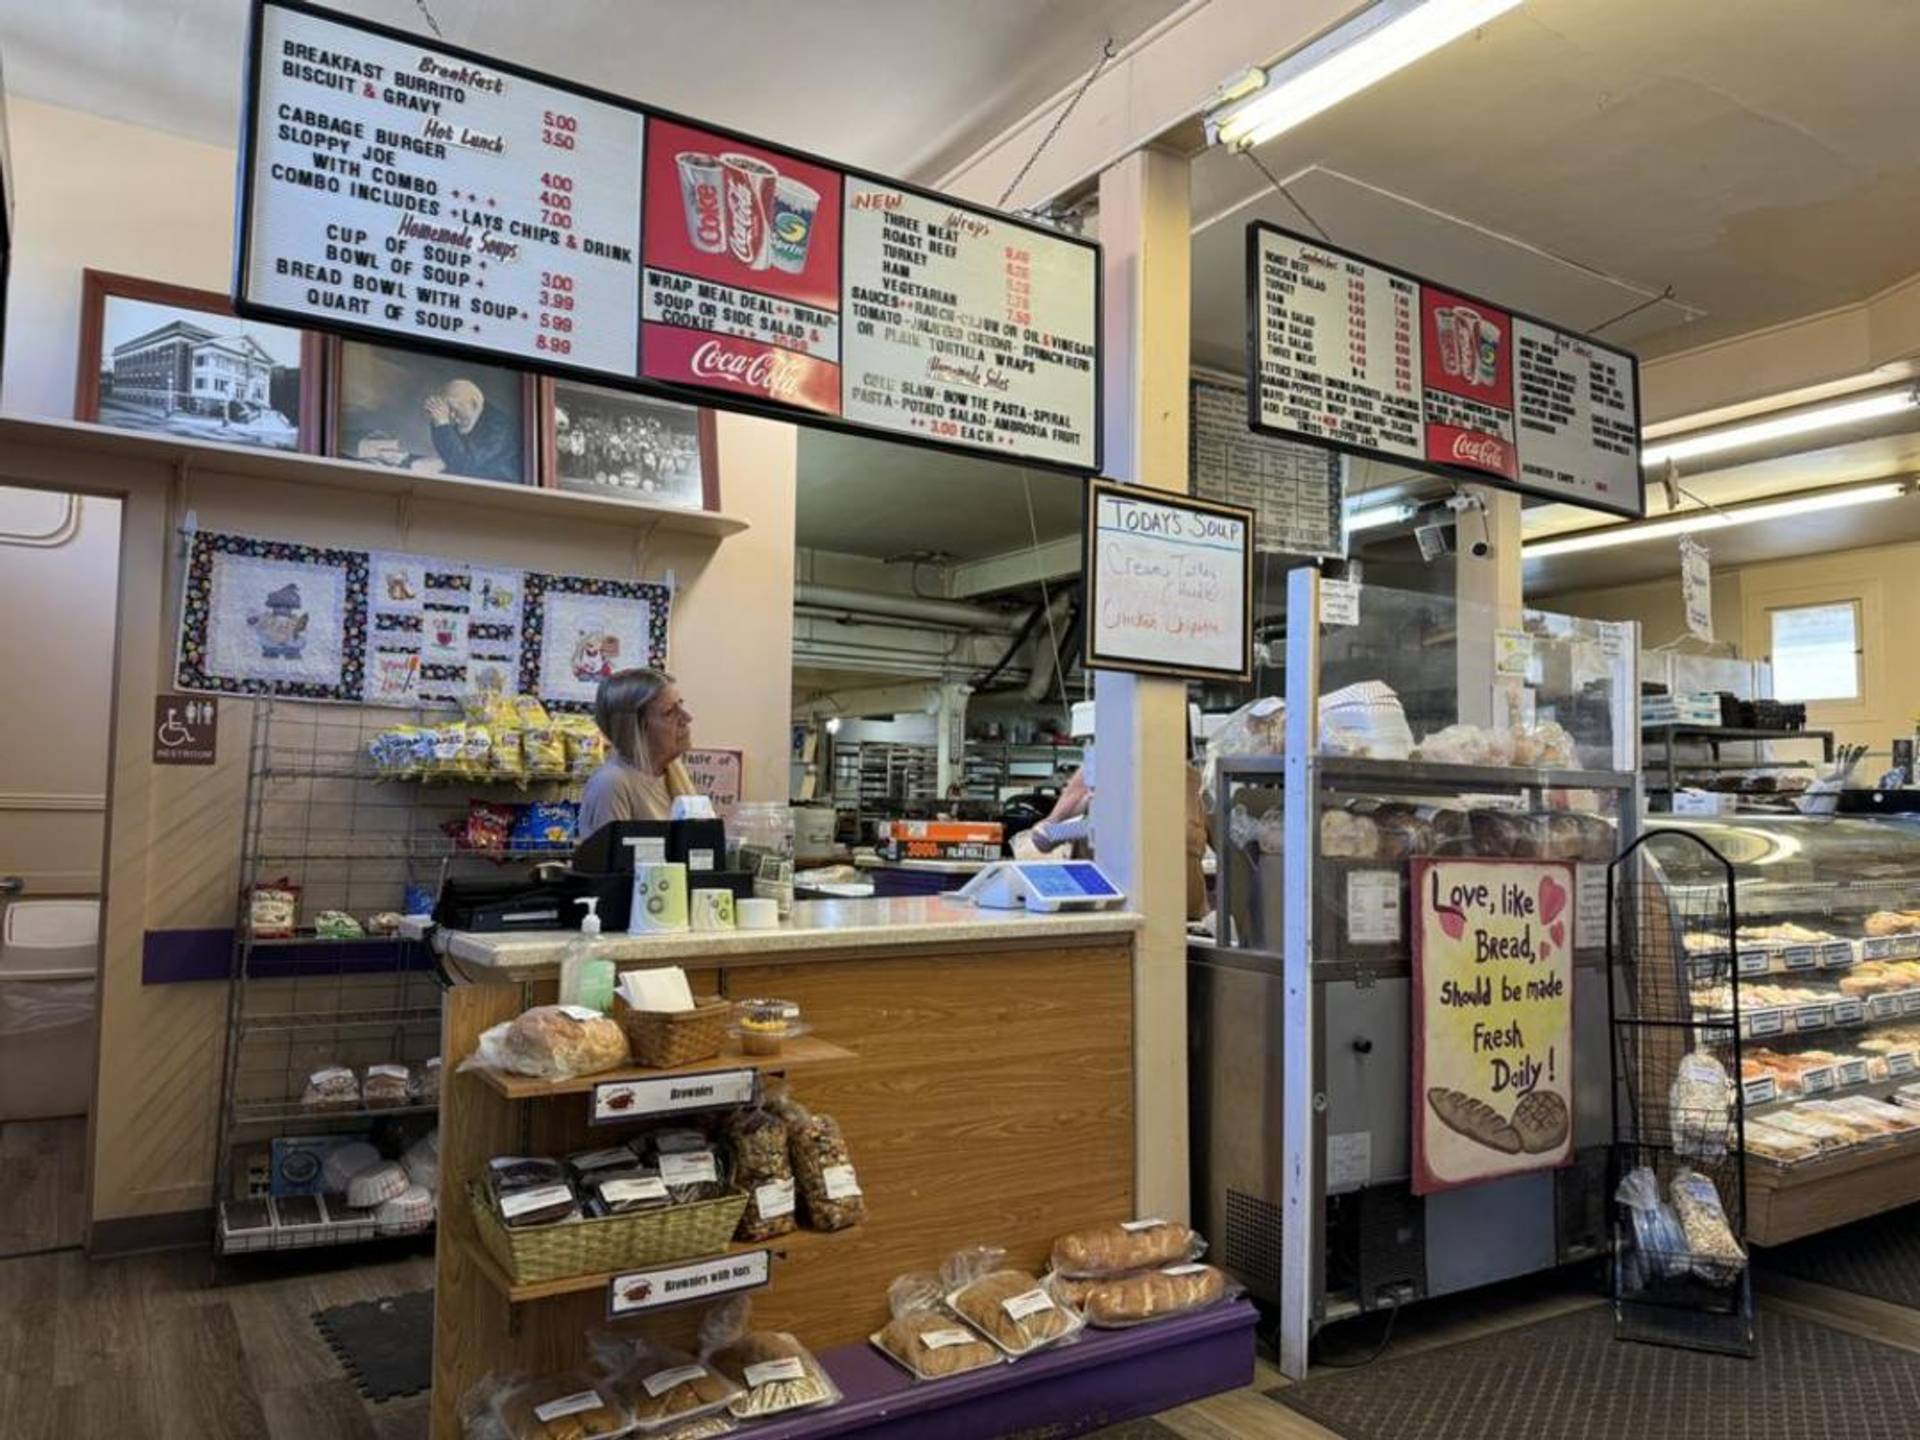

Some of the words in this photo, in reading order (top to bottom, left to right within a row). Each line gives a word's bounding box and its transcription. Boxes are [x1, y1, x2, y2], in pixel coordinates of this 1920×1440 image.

[284, 41, 384, 80] BREAKFAST
[395, 71, 465, 102] BURRITO
[543, 111, 577, 132] 5.00
[419, 57, 504, 94] Breakfast
[282, 63, 355, 94] BISCUIT
[363, 83, 376, 99] &
[383, 88, 441, 116] GRAVY
[542, 130, 575, 151] 3.50
[279, 103, 364, 138] CABBAGE
[376, 129, 446, 160] BURGER
[540, 172, 573, 192] 4.00
[424, 119, 453, 141] Hot
[461, 129, 504, 154] Lunch
[279, 125, 350, 155] SLOPPY
[363, 146, 397, 166] JOE
[539, 191, 572, 211] 4.00
[313, 152, 361, 178] WITH
[372, 166, 438, 196] COMBO
[541, 210, 572, 229] 7.00
[853, 194, 904, 210] NEW
[271, 163, 340, 193] COMBO
[350, 182, 441, 216] INCLUDES
[510, 222, 560, 246] CHIPS
[567, 234, 577, 249] &
[583, 238, 632, 262] DRINK
[884, 211, 920, 231] THREE
[928, 224, 960, 242] MEAT
[327, 224, 367, 245] CUP
[386, 238, 406, 254] OF
[424, 246, 472, 267] SOUP
[541, 272, 573, 292] 3.00
[399, 214, 473, 249] Homemade
[476, 236, 519, 264] Soups
[883, 228, 922, 247] ROAST
[929, 238, 958, 258] BEEF
[883, 244, 927, 265] TURKEY
[326, 245, 379, 270] BOWL
[391, 259, 413, 276] OF
[423, 266, 470, 288] SOUP
[883, 261, 910, 278] HAM
[276, 258, 342, 285] BREAD
[353, 273, 406, 299] BOWL
[416, 286, 460, 309] WITH
[471, 298, 518, 320] SOUP
[307, 289, 370, 315] QUART
[385, 305, 404, 319] OF
[416, 310, 463, 332] SOUP
[649, 271, 692, 295] WRAP
[698, 284, 735, 306] MEAL
[740, 296, 774, 316] DEAL
[882, 277, 957, 305] VEGETARIAN
[654, 292, 693, 315] SOUP
[700, 302, 717, 318] OR
[722, 307, 754, 328] SIDE
[760, 318, 804, 340] SALAD
[851, 286, 899, 309] SAUCES
[1003, 321, 1017, 337] OR
[857, 322, 874, 337] OR
[995, 353, 1035, 374] WRAPS
[971, 395, 988, 412] TIE
[961, 425, 994, 443] EACH
[1432, 870, 1495, 922] Love,
[1501, 884, 1535, 917] like
[1502, 976, 1521, 1002] be
[1527, 975, 1564, 1001] made
[670, 1085, 714, 1100] Brownies
[664, 1272, 708, 1293] Brownies
